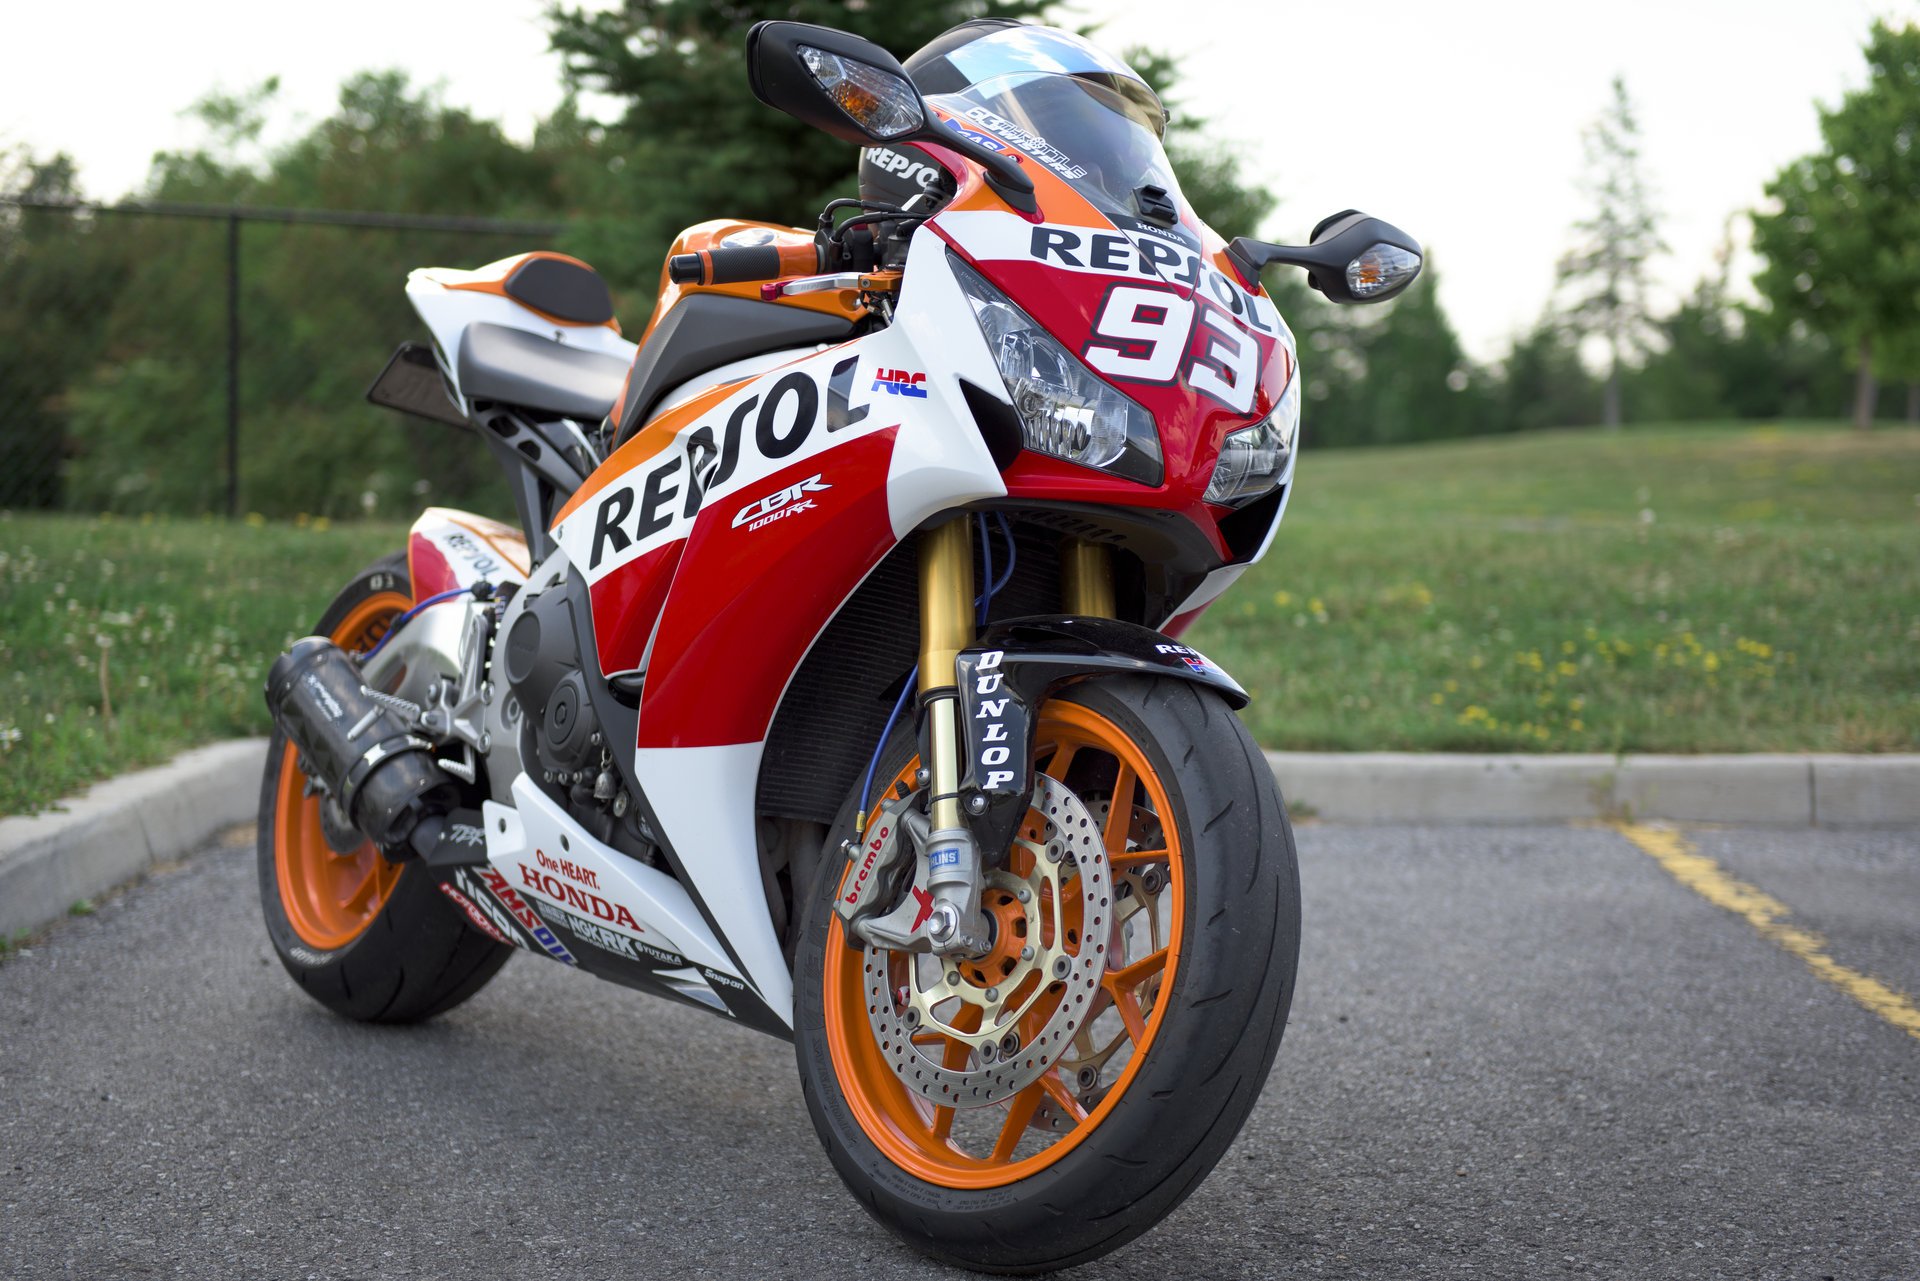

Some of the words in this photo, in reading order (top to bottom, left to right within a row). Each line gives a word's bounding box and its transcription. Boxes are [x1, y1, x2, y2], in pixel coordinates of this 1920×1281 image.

[866, 147, 939, 189] REPSO
[1136, 222, 1187, 245] HONDA
[1030, 226, 1272, 333] REPSOL
[870, 367, 928, 399] HRC
[1081, 282, 1262, 420] 93
[589, 354, 871, 571] REPSOL
[731, 473, 833, 529] CBR
[975, 651, 1015, 790] DUNLOP
[536, 849, 559, 873] One
[560, 858, 601, 891] HEART.
[845, 826, 889, 905] brembo
[518, 862, 645, 934] HONDA
[704, 968, 744, 991] Snap-on
